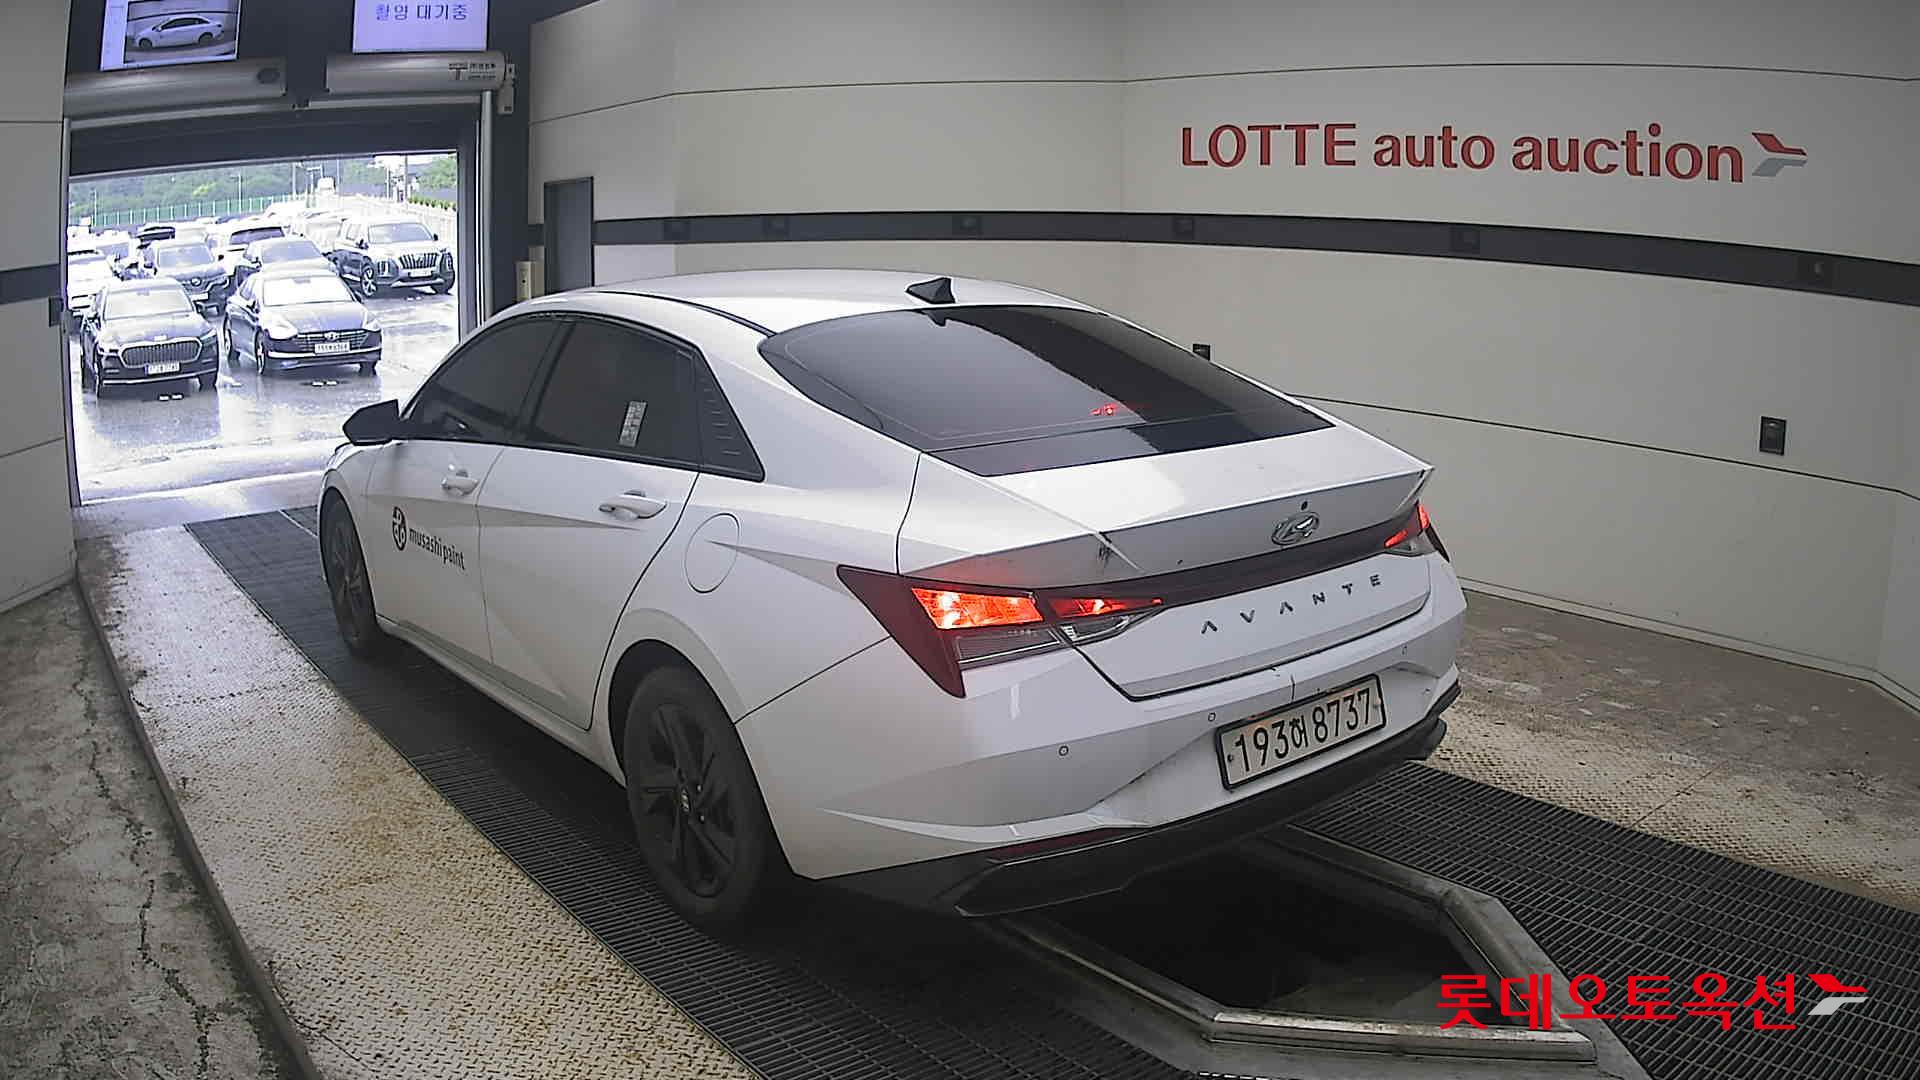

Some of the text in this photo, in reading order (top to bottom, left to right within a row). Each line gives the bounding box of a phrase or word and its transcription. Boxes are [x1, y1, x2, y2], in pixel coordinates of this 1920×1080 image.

[417, 4, 467, 21] 대기중
[1182, 123, 1743, 183] LOTTE auto auction
[1201, 574, 1382, 635] AVANTE
[1312, 688, 1371, 744] 8737
